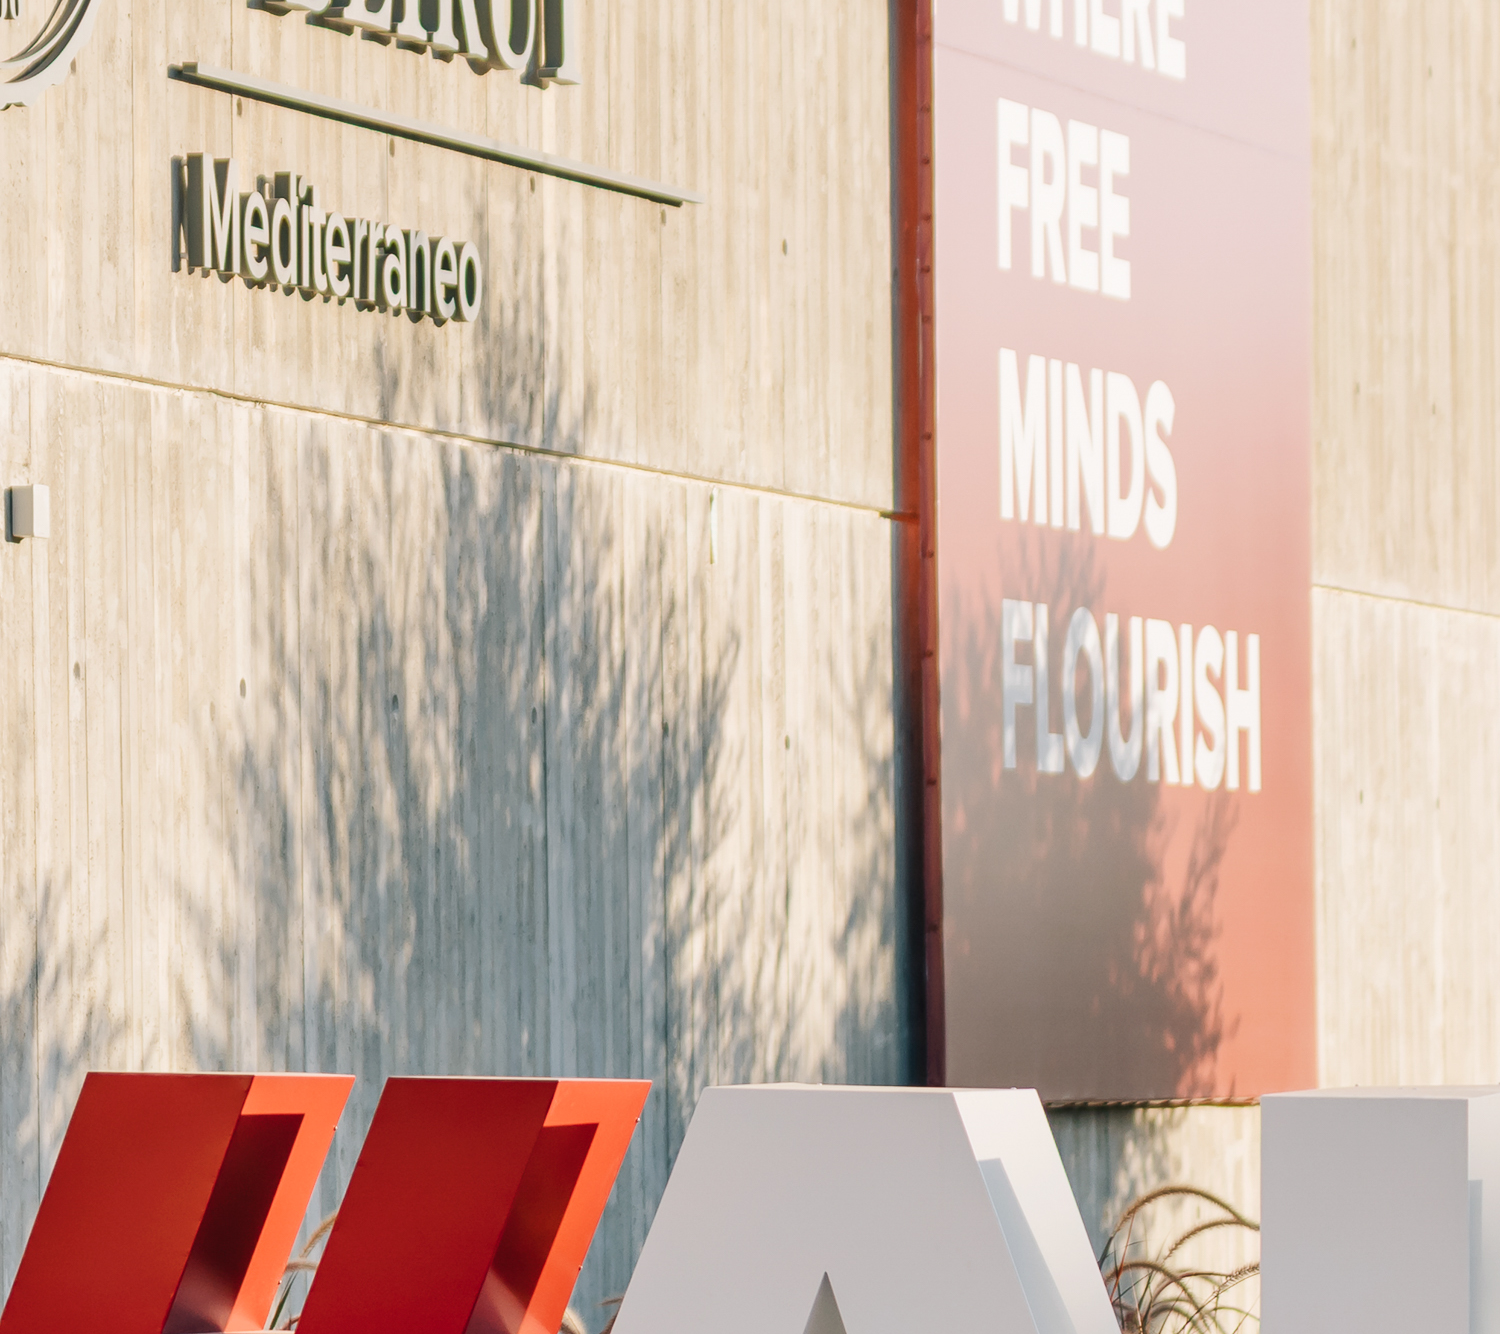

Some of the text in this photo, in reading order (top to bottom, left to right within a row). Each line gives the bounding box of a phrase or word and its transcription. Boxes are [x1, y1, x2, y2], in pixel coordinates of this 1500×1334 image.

[199, 152, 483, 323] Mediterraneo
[998, 97, 1131, 299] FREE
[1000, 347, 1177, 549] MINDS
[1002, 598, 1261, 793] FLOURISH
